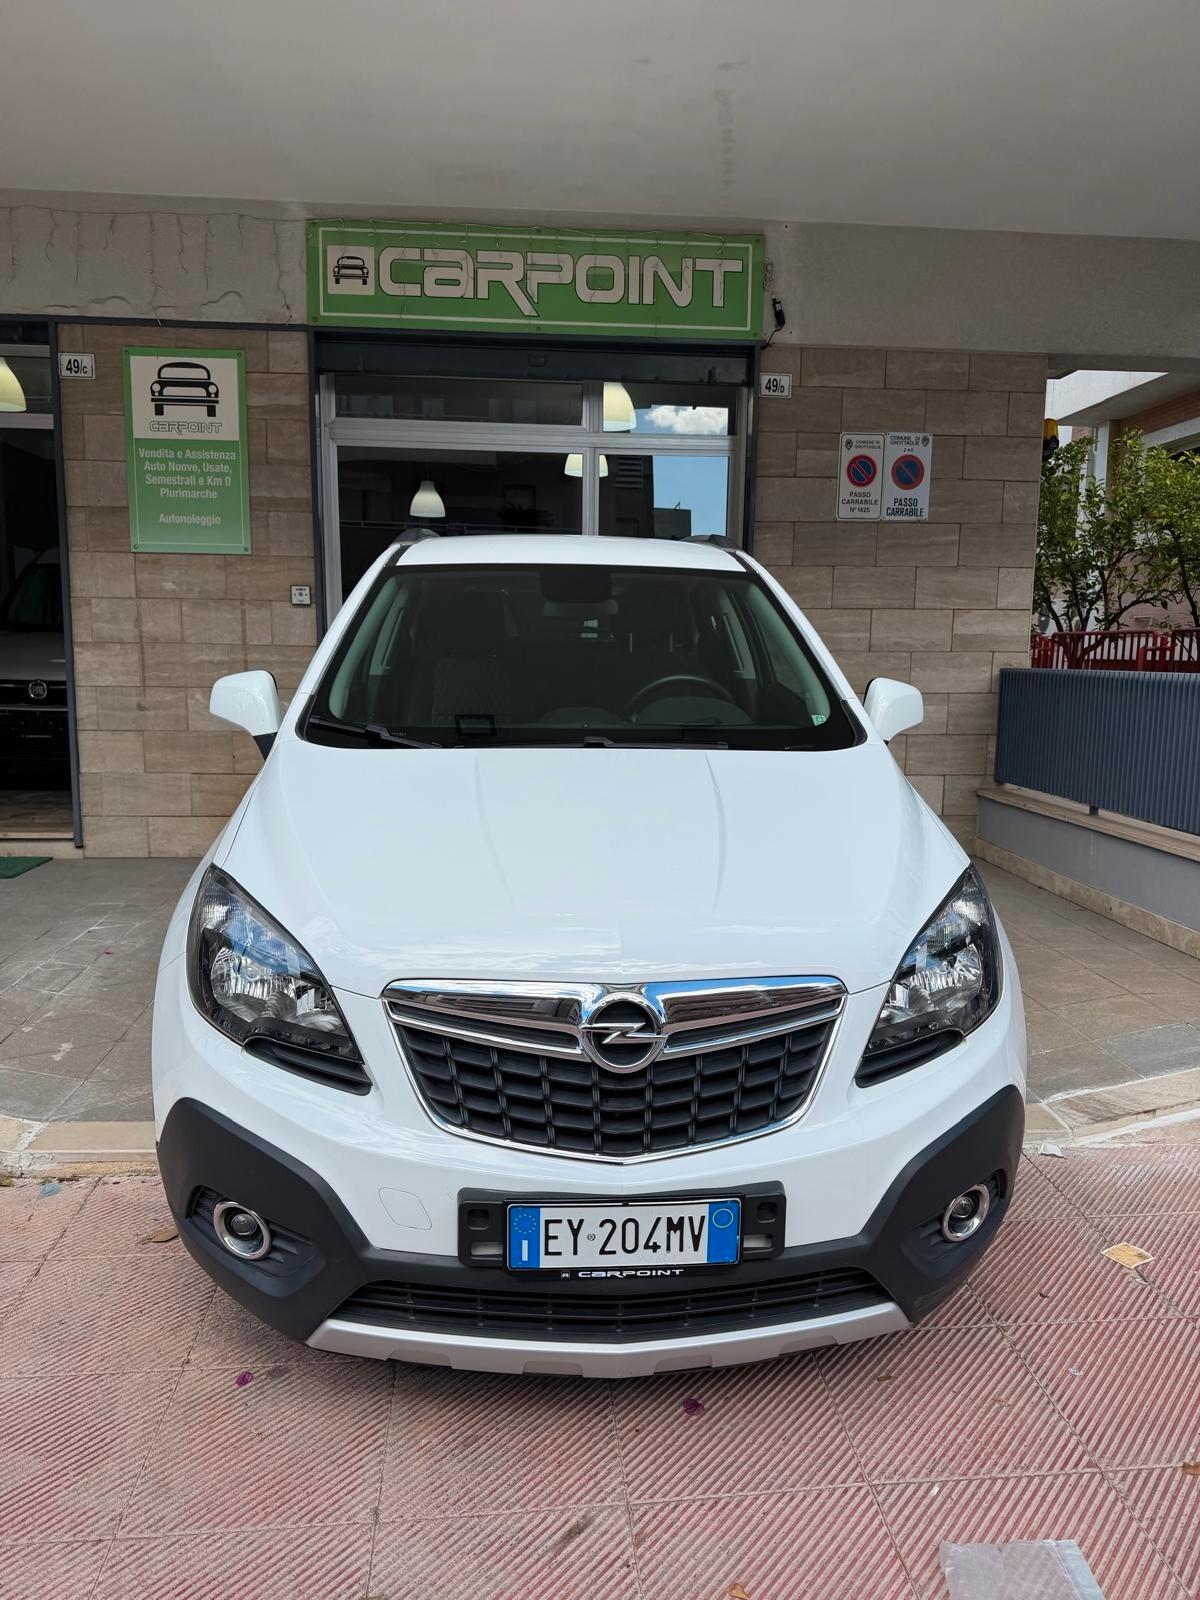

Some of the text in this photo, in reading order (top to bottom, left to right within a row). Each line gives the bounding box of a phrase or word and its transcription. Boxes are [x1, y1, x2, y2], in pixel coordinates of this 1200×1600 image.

[139, 448, 236, 460] Vendita e Assistenza
[144, 461, 233, 474] Auto Nuove, Usate,
[145, 474, 196, 486] Semestrali
[199, 477, 205, 486] e
[207, 476, 222, 486] Km
[160, 488, 218, 499] Plurimarche
[893, 498, 918, 507] PASSO
[886, 507, 924, 517] CARRABILE
[159, 514, 221, 526] Autonoleggio
[543, 1215, 707, 1257] EY 204MV
